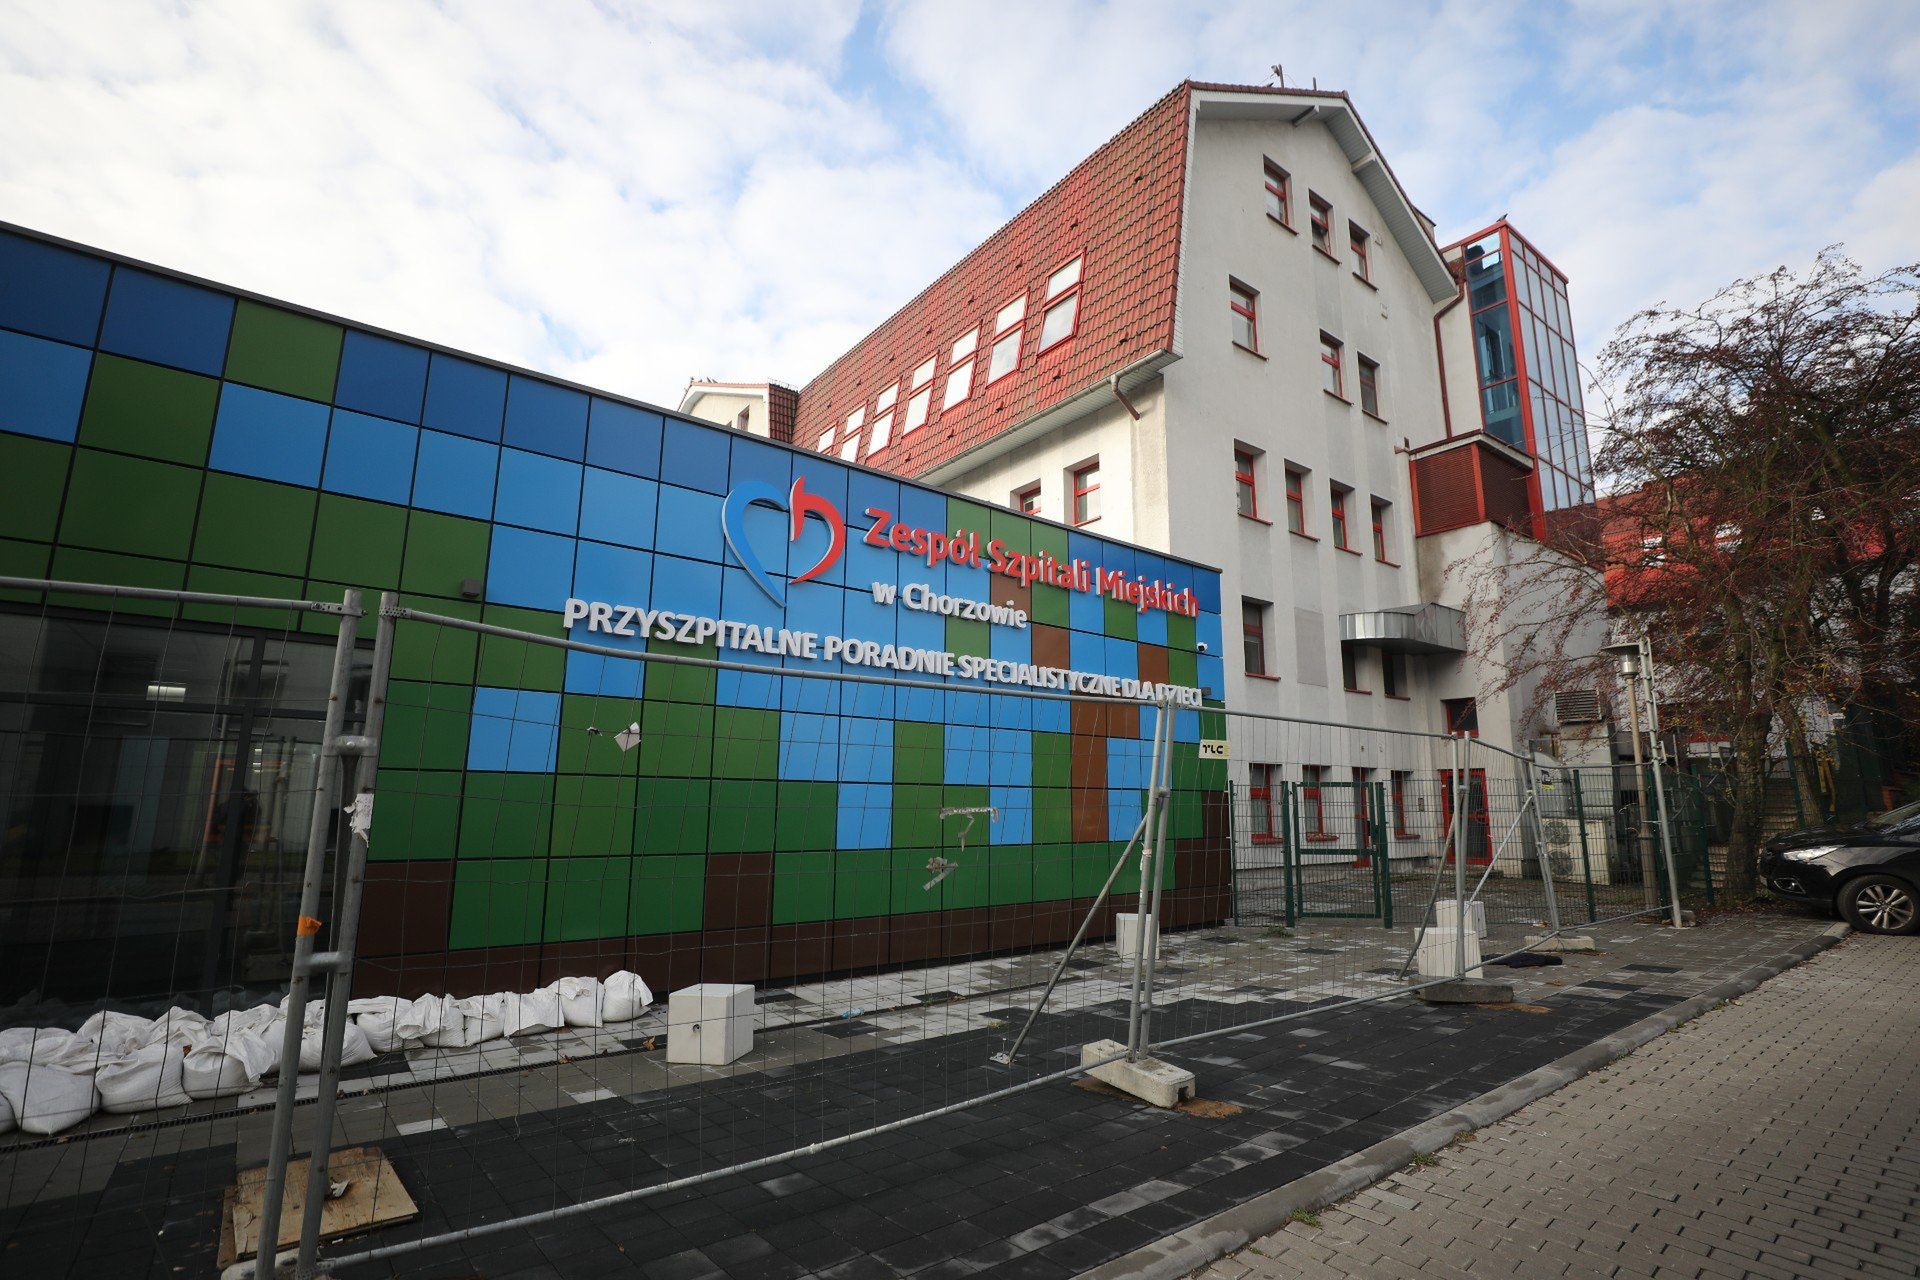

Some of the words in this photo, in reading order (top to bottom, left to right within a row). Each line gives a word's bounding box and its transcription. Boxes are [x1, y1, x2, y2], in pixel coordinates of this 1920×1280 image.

[863, 507, 982, 568] Zespół
[986, 540, 1091, 593] Szpitali
[1096, 566, 1199, 618] Miejskich
[872, 581, 897, 606] w
[902, 583, 1028, 629] Chorzowie
[563, 598, 818, 659] PRZYSZPITALNE
[824, 636, 954, 677] PORADNIE
[957, 654, 1121, 697] SPECJALISTYCZNE
[1122, 678, 1156, 701] DLA
